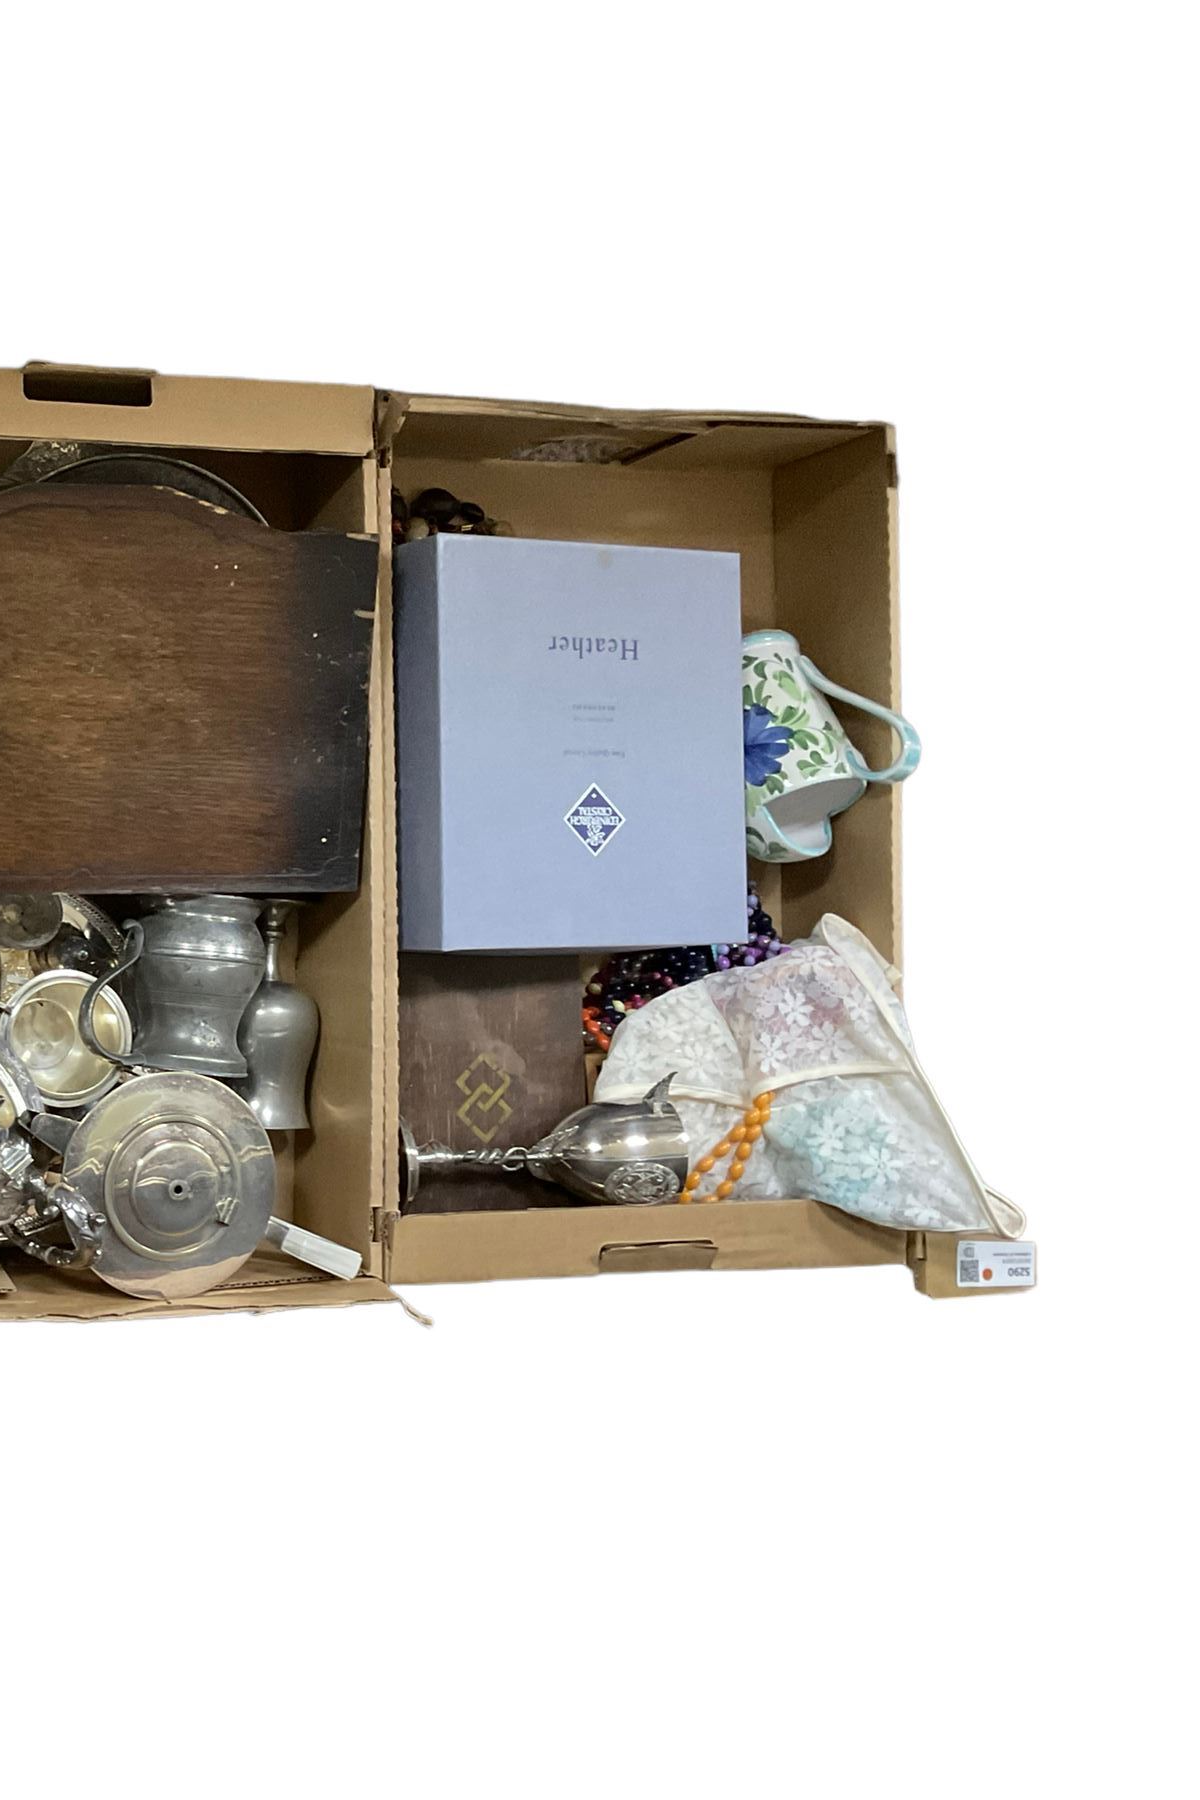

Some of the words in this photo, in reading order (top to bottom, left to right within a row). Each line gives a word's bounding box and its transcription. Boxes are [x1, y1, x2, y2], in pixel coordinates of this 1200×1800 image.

[548, 636, 639, 661] Heather
[577, 806, 613, 816] CRYSTAL
[570, 815, 619, 826] EDINBURGH
[1007, 1267, 1031, 1277] 5290
